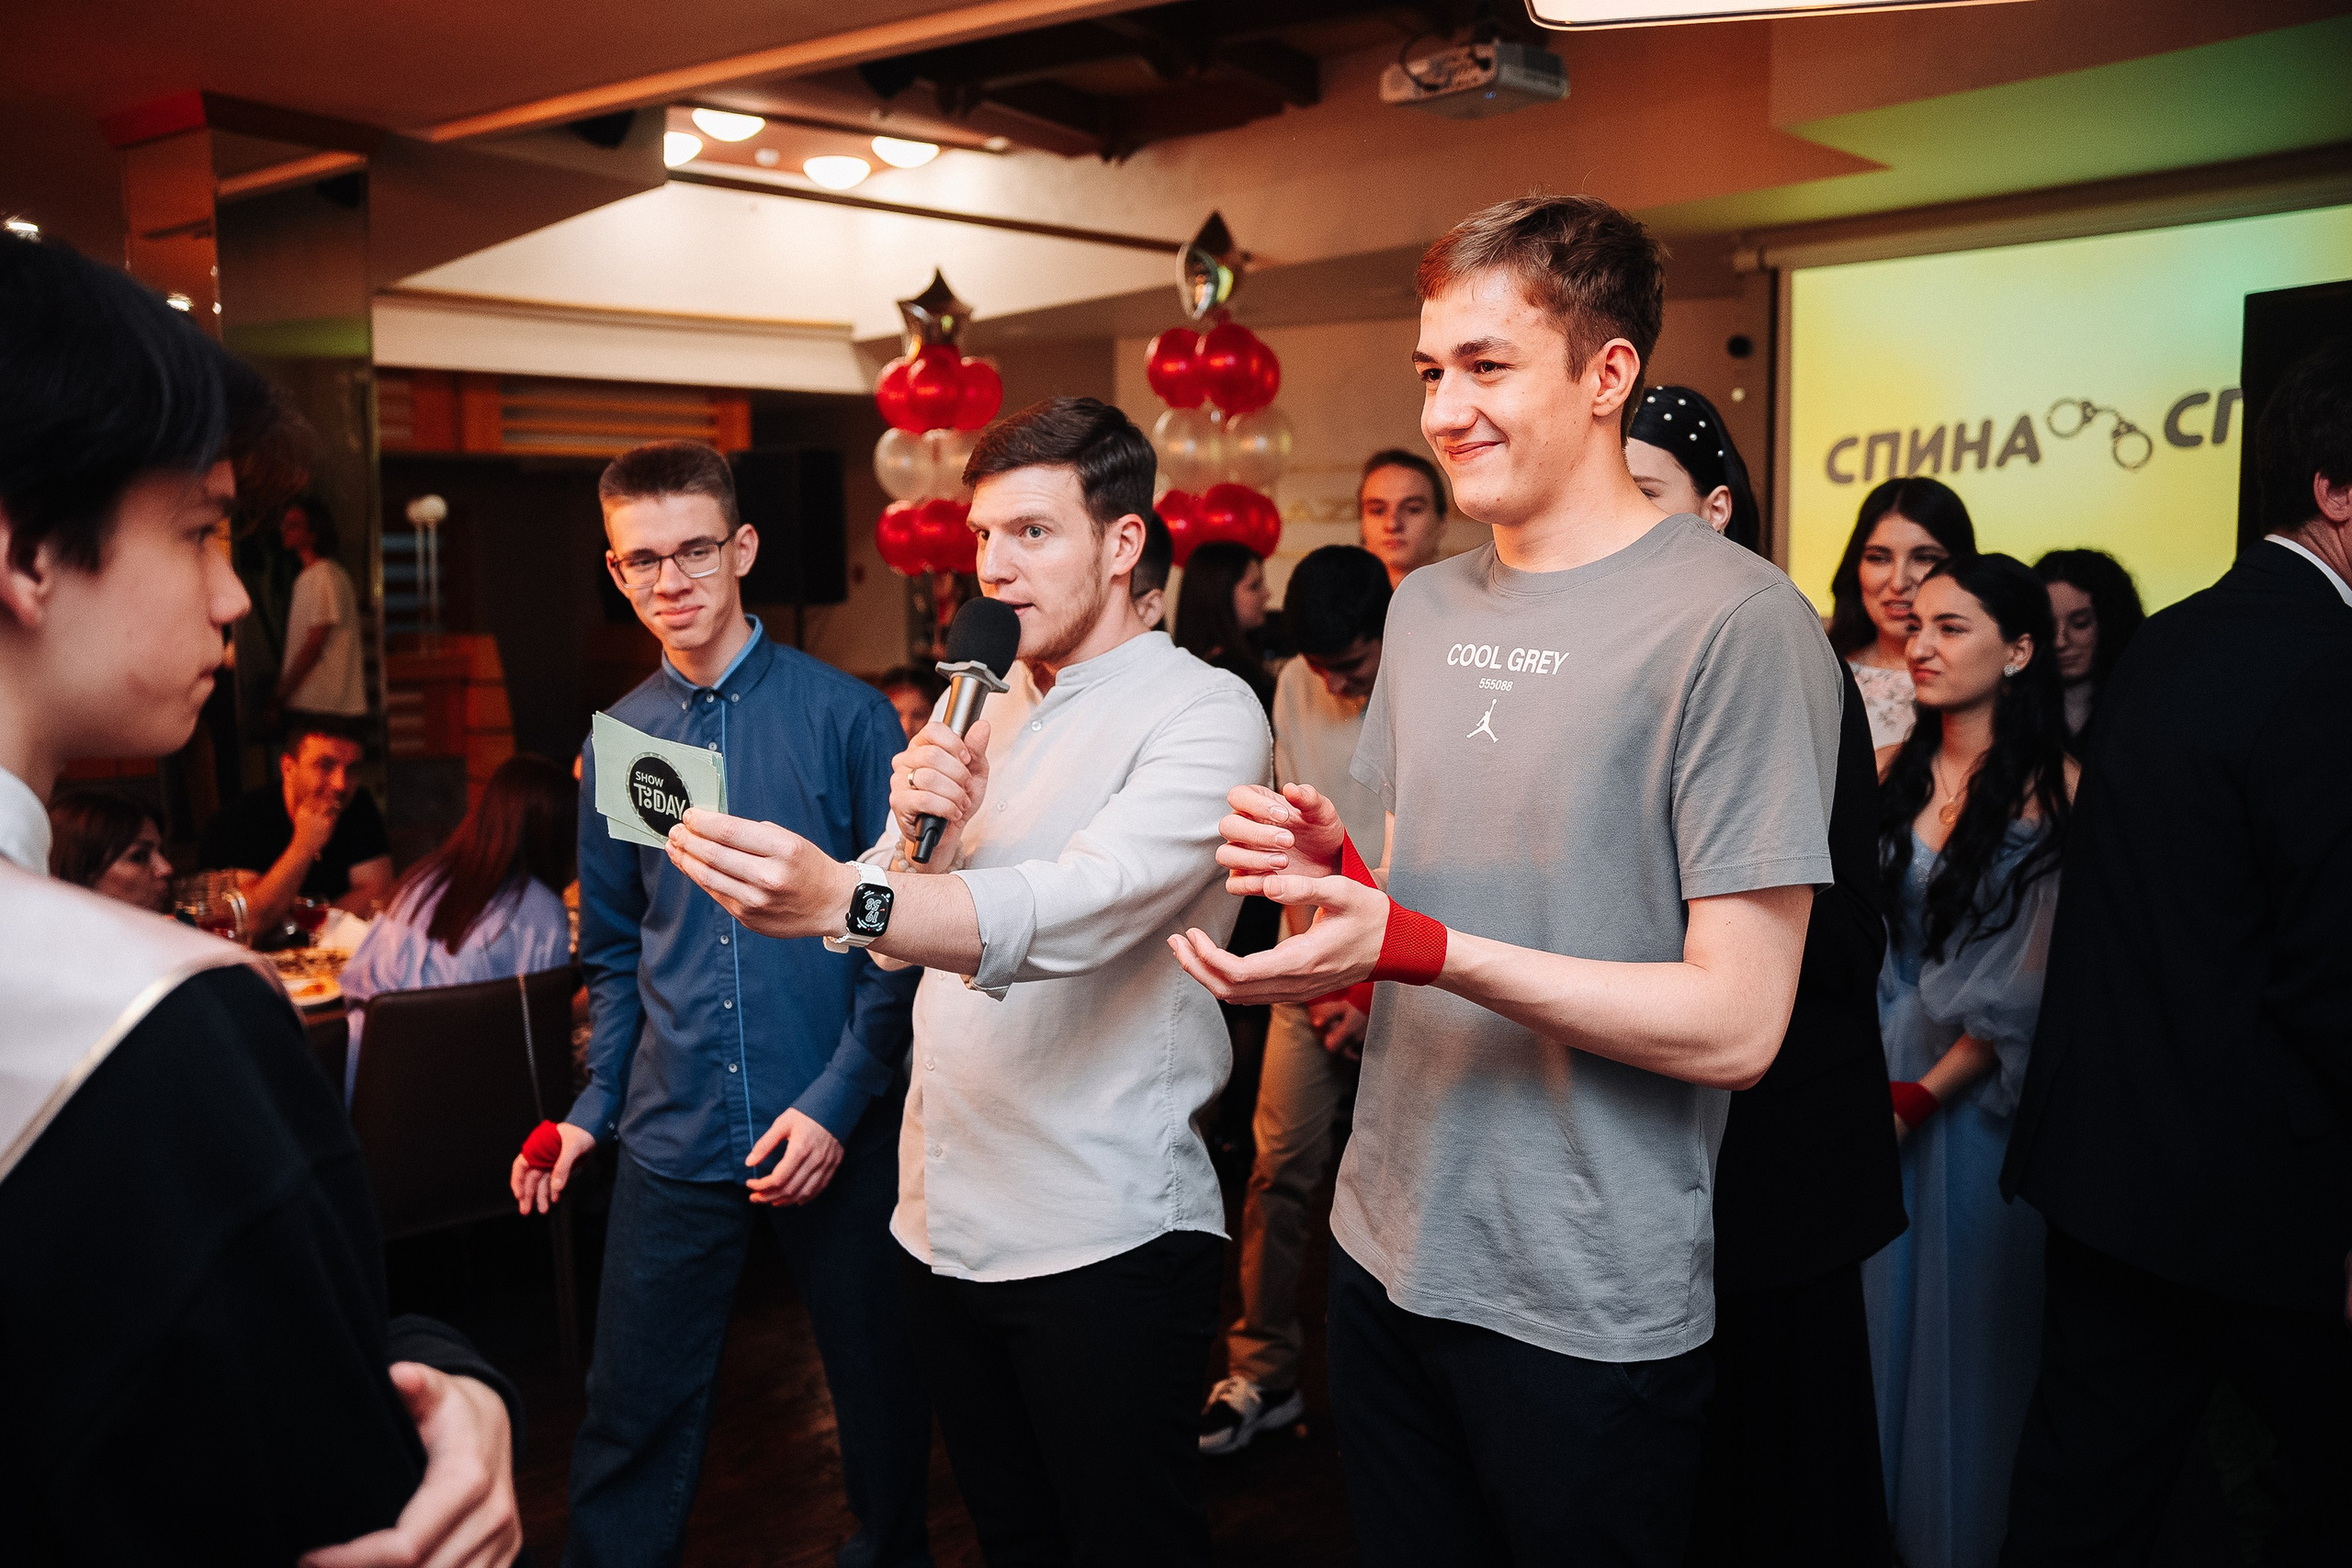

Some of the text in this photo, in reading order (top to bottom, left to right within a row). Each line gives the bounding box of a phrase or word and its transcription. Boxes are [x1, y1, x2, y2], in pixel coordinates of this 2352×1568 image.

[1826, 414, 2041, 484] СПИНА
[1446, 643, 1570, 675] COOL GREY
[1478, 677, 1513, 692] 555088
[635, 771, 664, 787] SHOW
